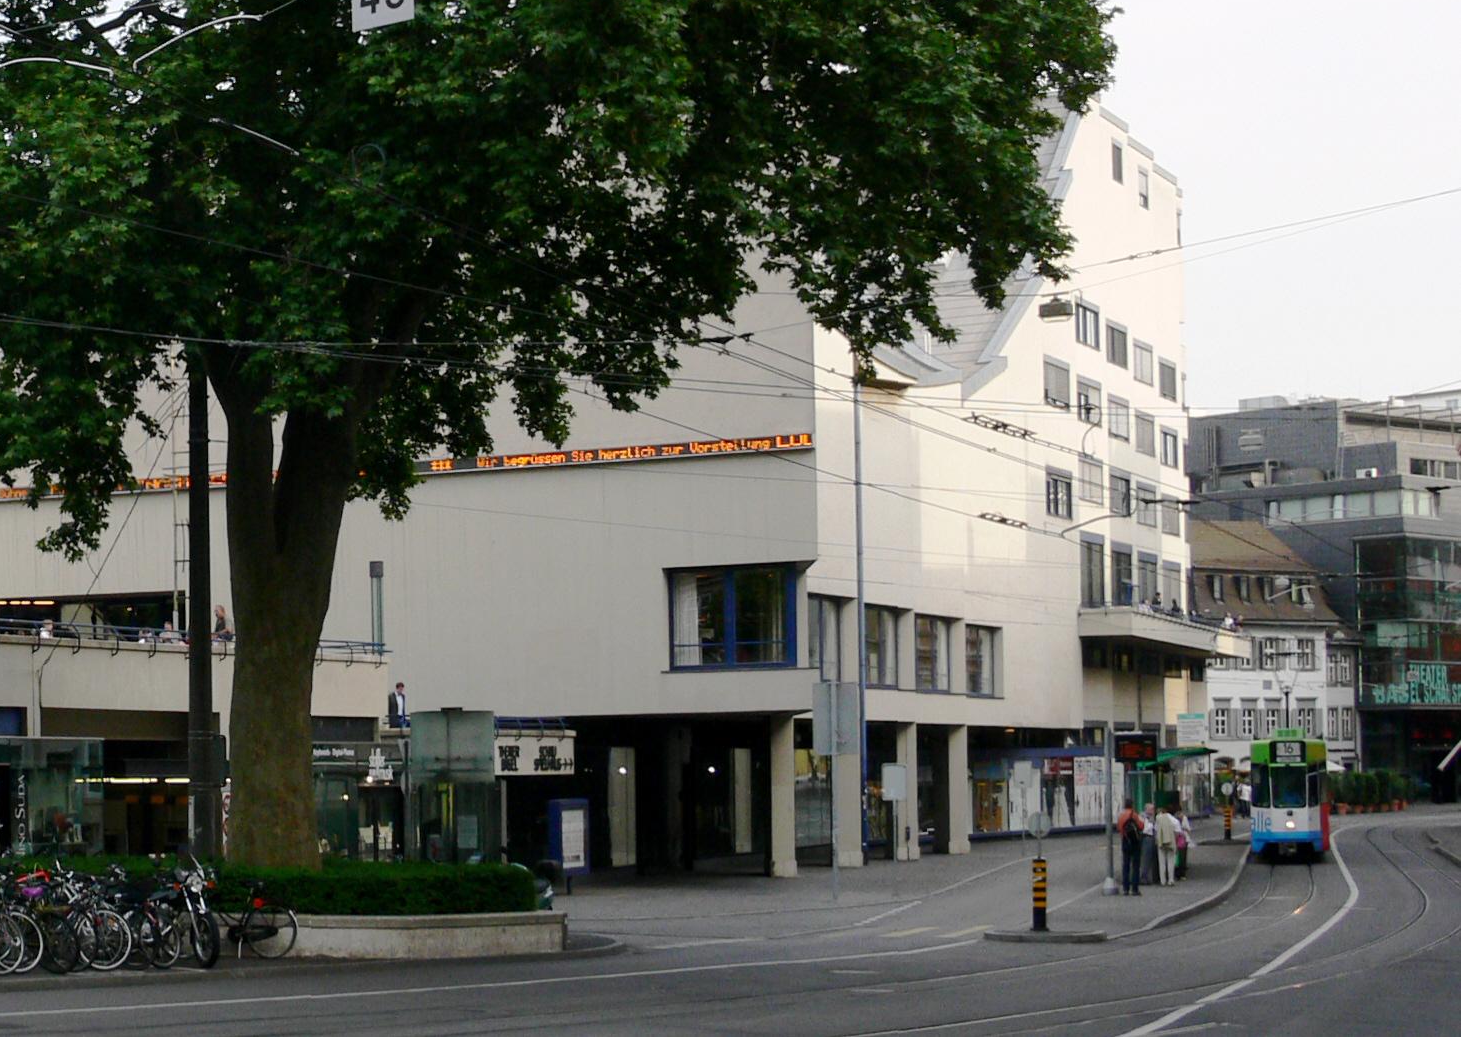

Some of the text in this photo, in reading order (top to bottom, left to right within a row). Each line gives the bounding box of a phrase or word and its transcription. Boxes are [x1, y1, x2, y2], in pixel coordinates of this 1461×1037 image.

[504, 453, 566, 468] begrüssen
[571, 450, 593, 462] Sie
[599, 445, 656, 461] herzlich
[661, 445, 684, 456] zur
[689, 437, 771, 455] Vorstellung
[1283, 743, 1294, 755] 16
